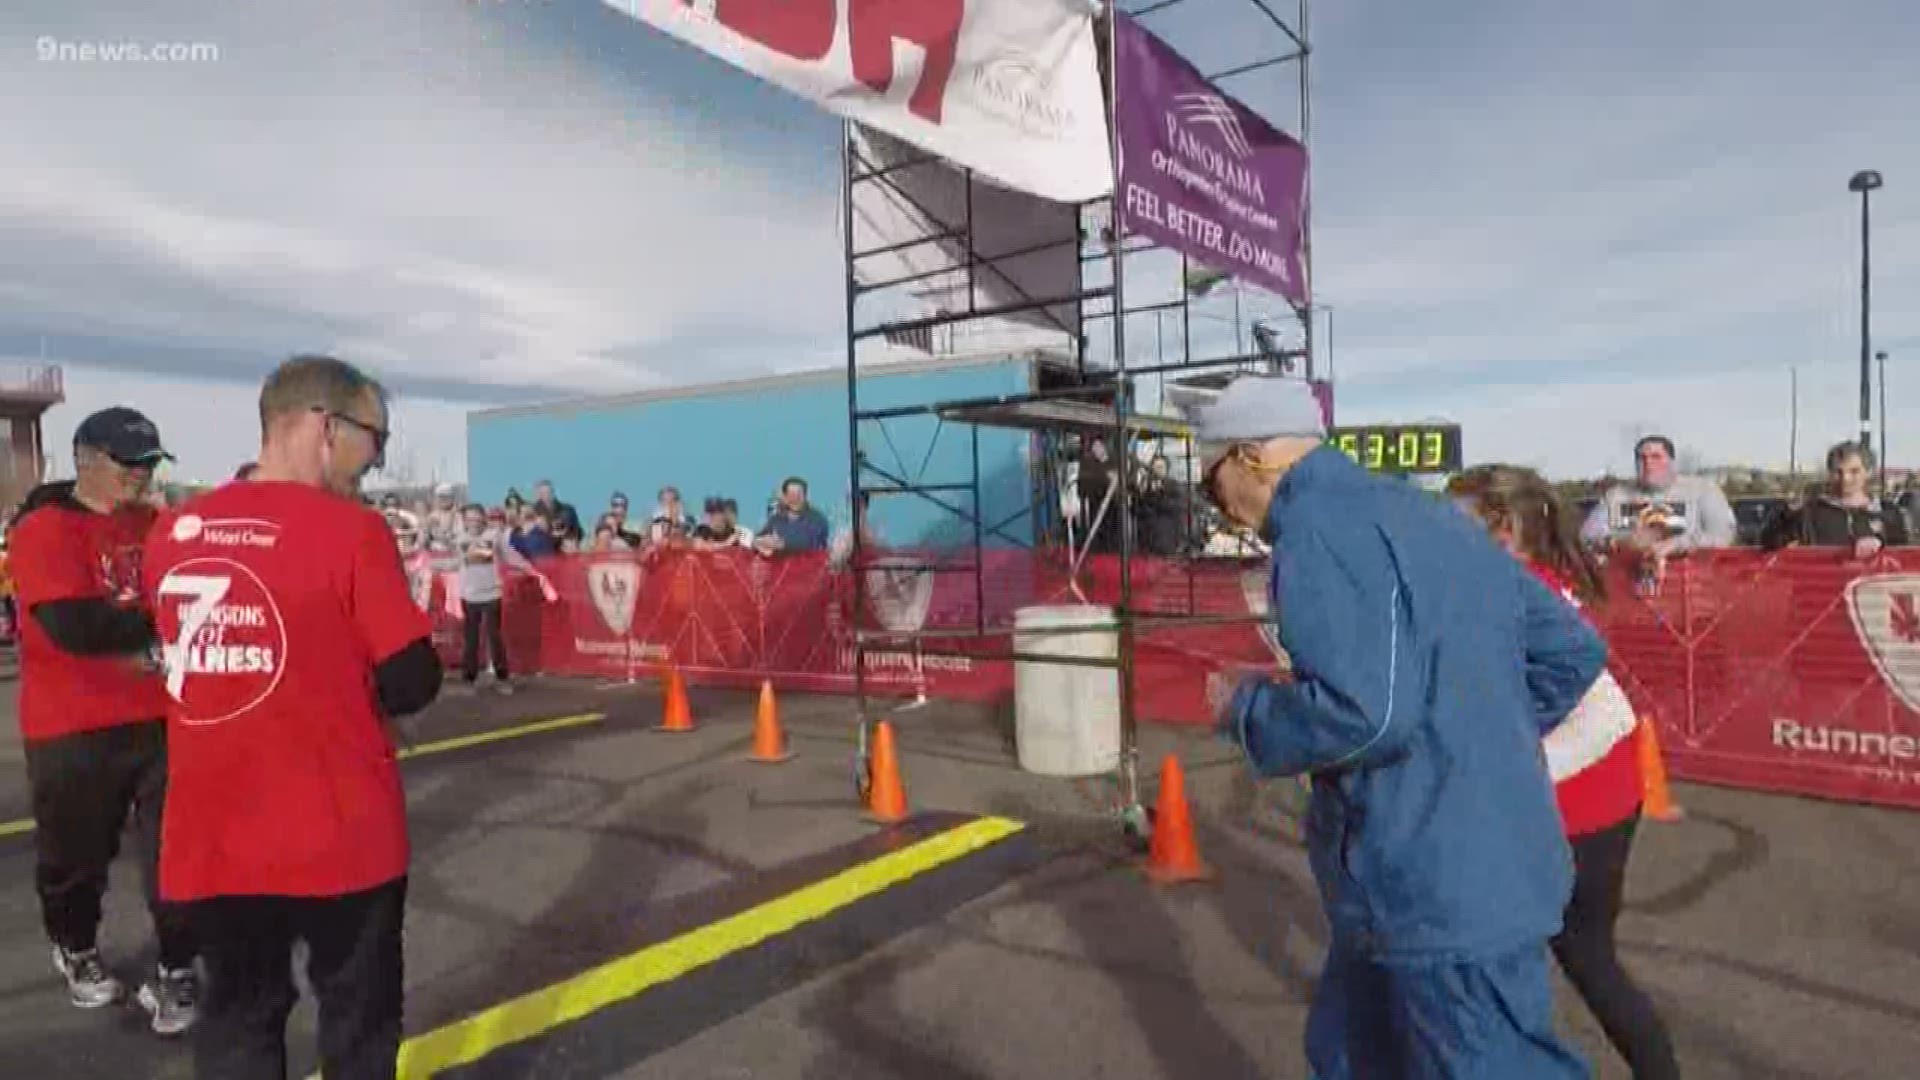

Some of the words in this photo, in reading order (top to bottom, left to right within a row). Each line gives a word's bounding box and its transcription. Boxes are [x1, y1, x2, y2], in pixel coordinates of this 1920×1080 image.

[1165, 111, 1266, 206] PANORAMA
[1126, 182, 1165, 226] FEEL
[1166, 201, 1228, 256] BETTER.
[1228, 229, 1253, 264] DO
[1771, 717, 1920, 759] Runne
